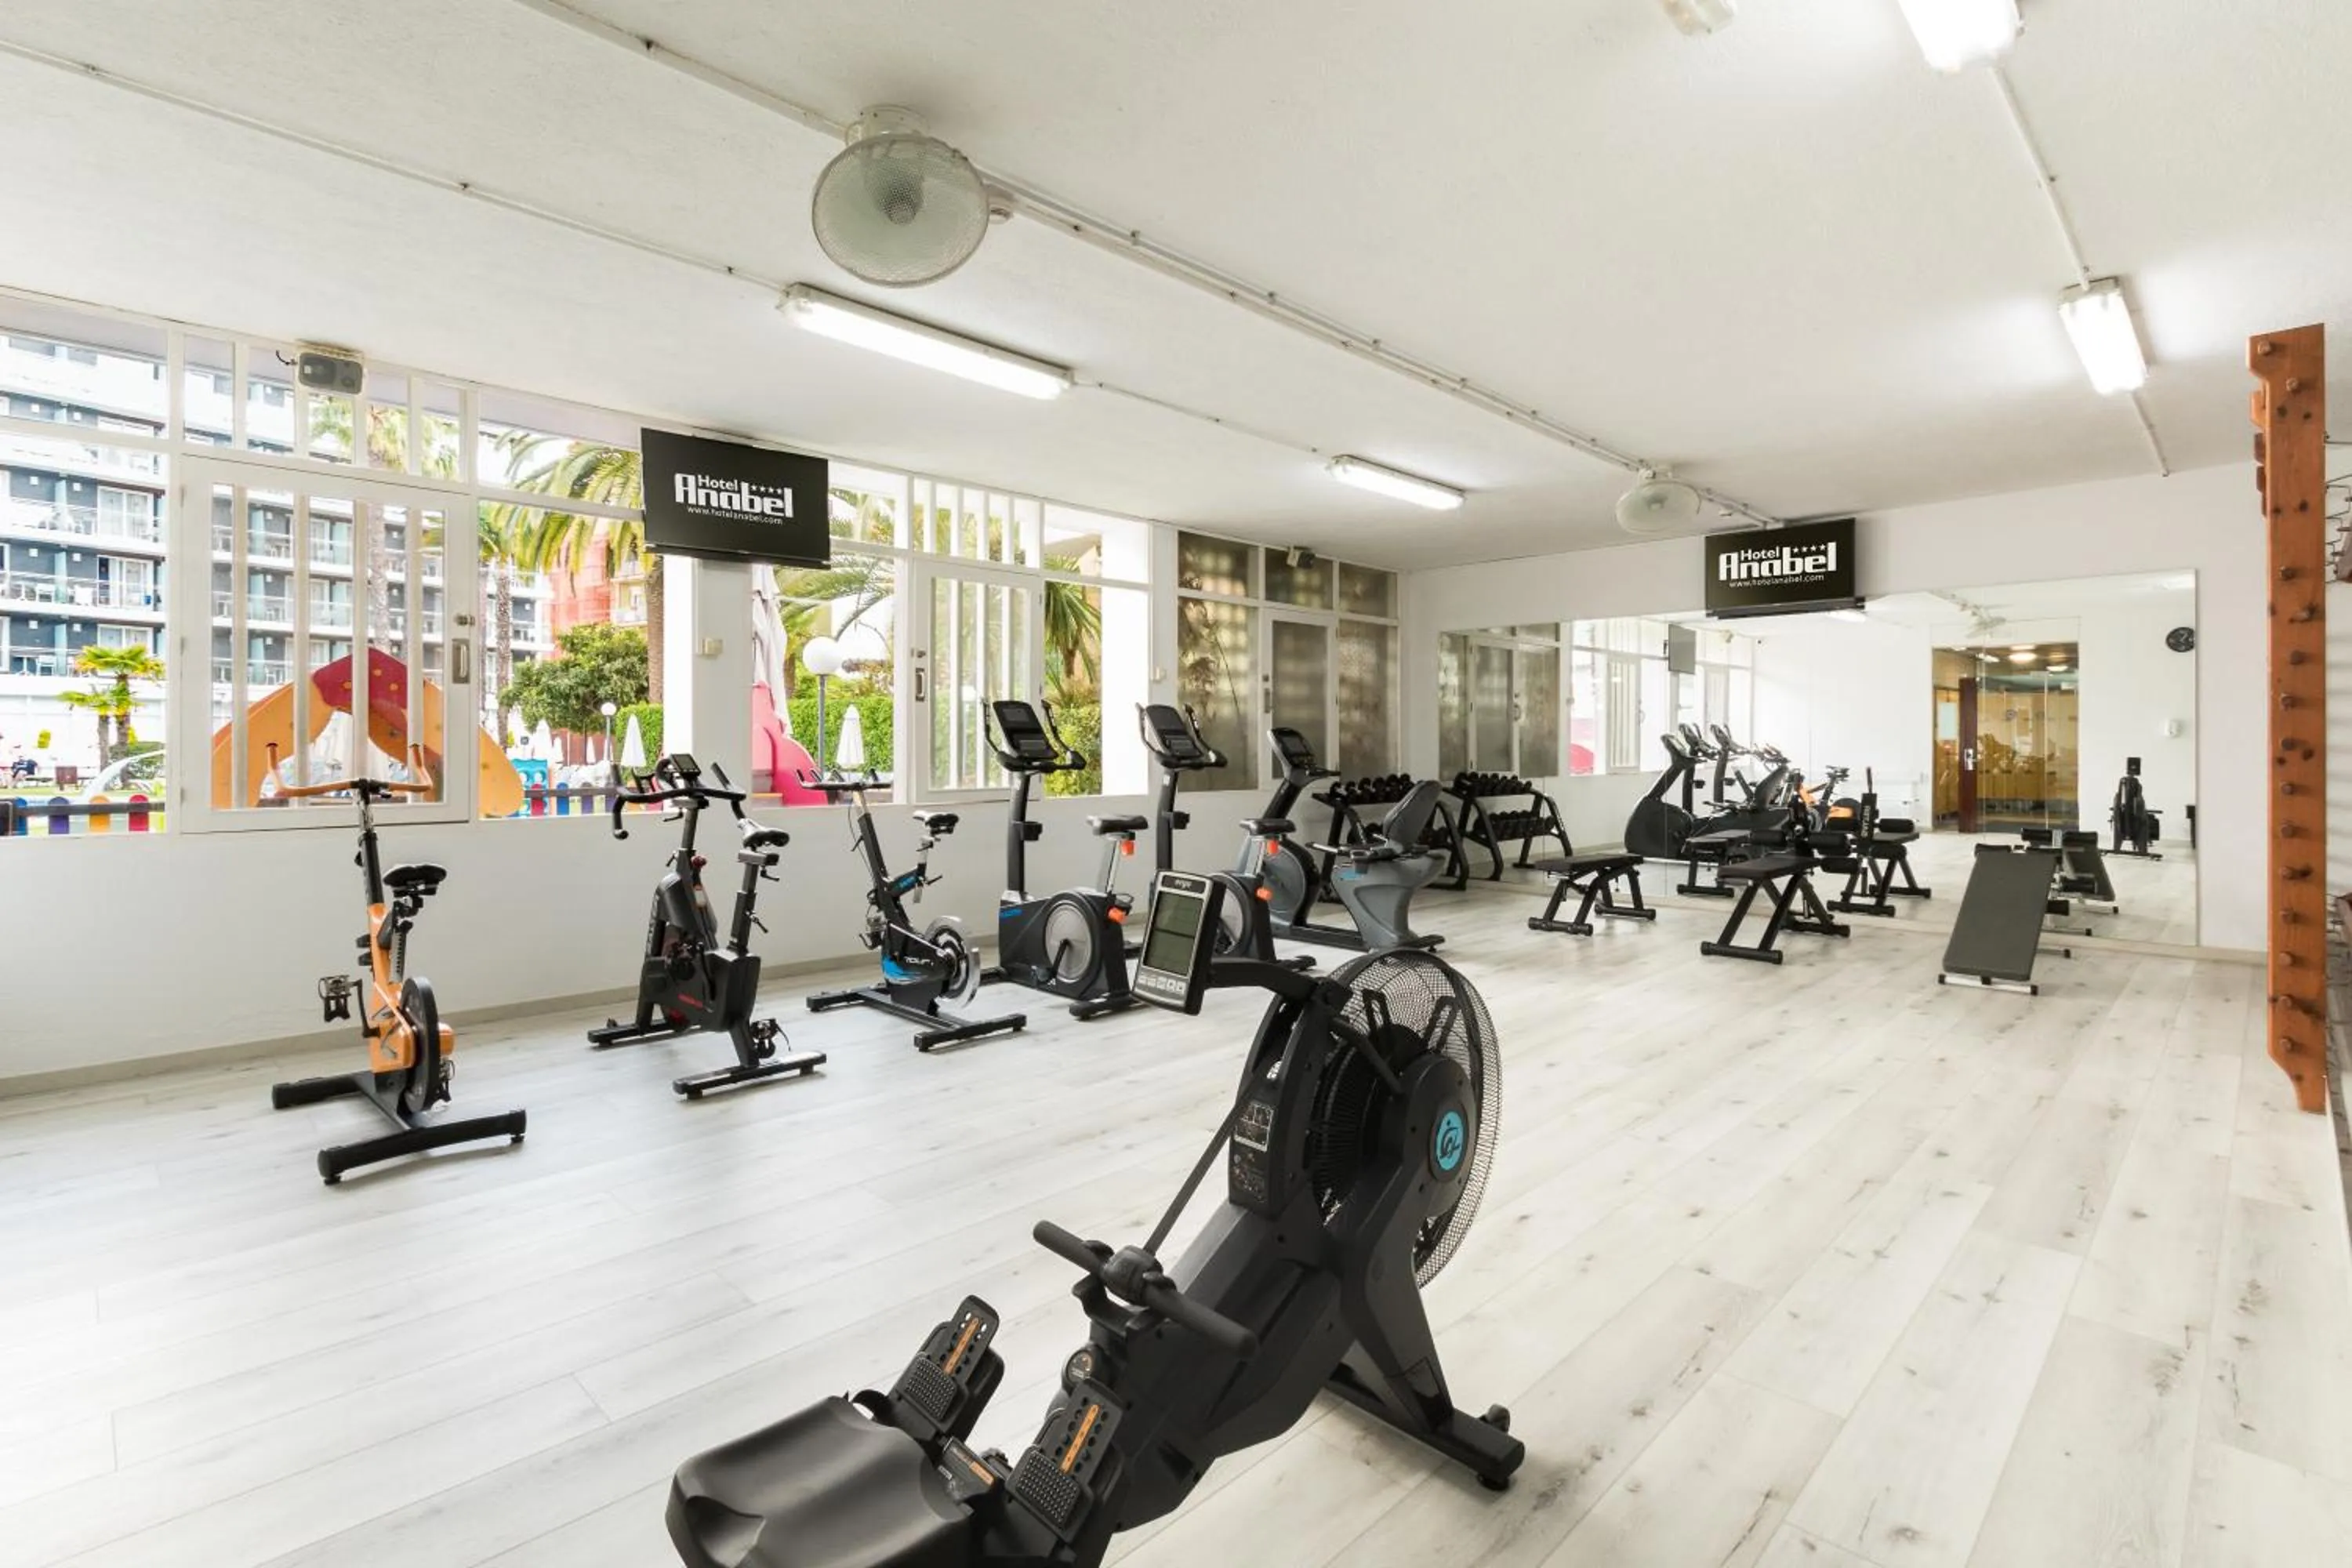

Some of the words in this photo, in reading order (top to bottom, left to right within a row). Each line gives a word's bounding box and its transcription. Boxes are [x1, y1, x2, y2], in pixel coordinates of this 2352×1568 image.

[697, 474, 738, 492] Hotel
[674, 473, 793, 518] Anabel
[687, 506, 783, 525] www.hotelanabel.com
[1719, 542, 1837, 581] Anabel
[1740, 546, 1780, 561] Hotel
[1729, 574, 1824, 588] www.hotelanabel.com
